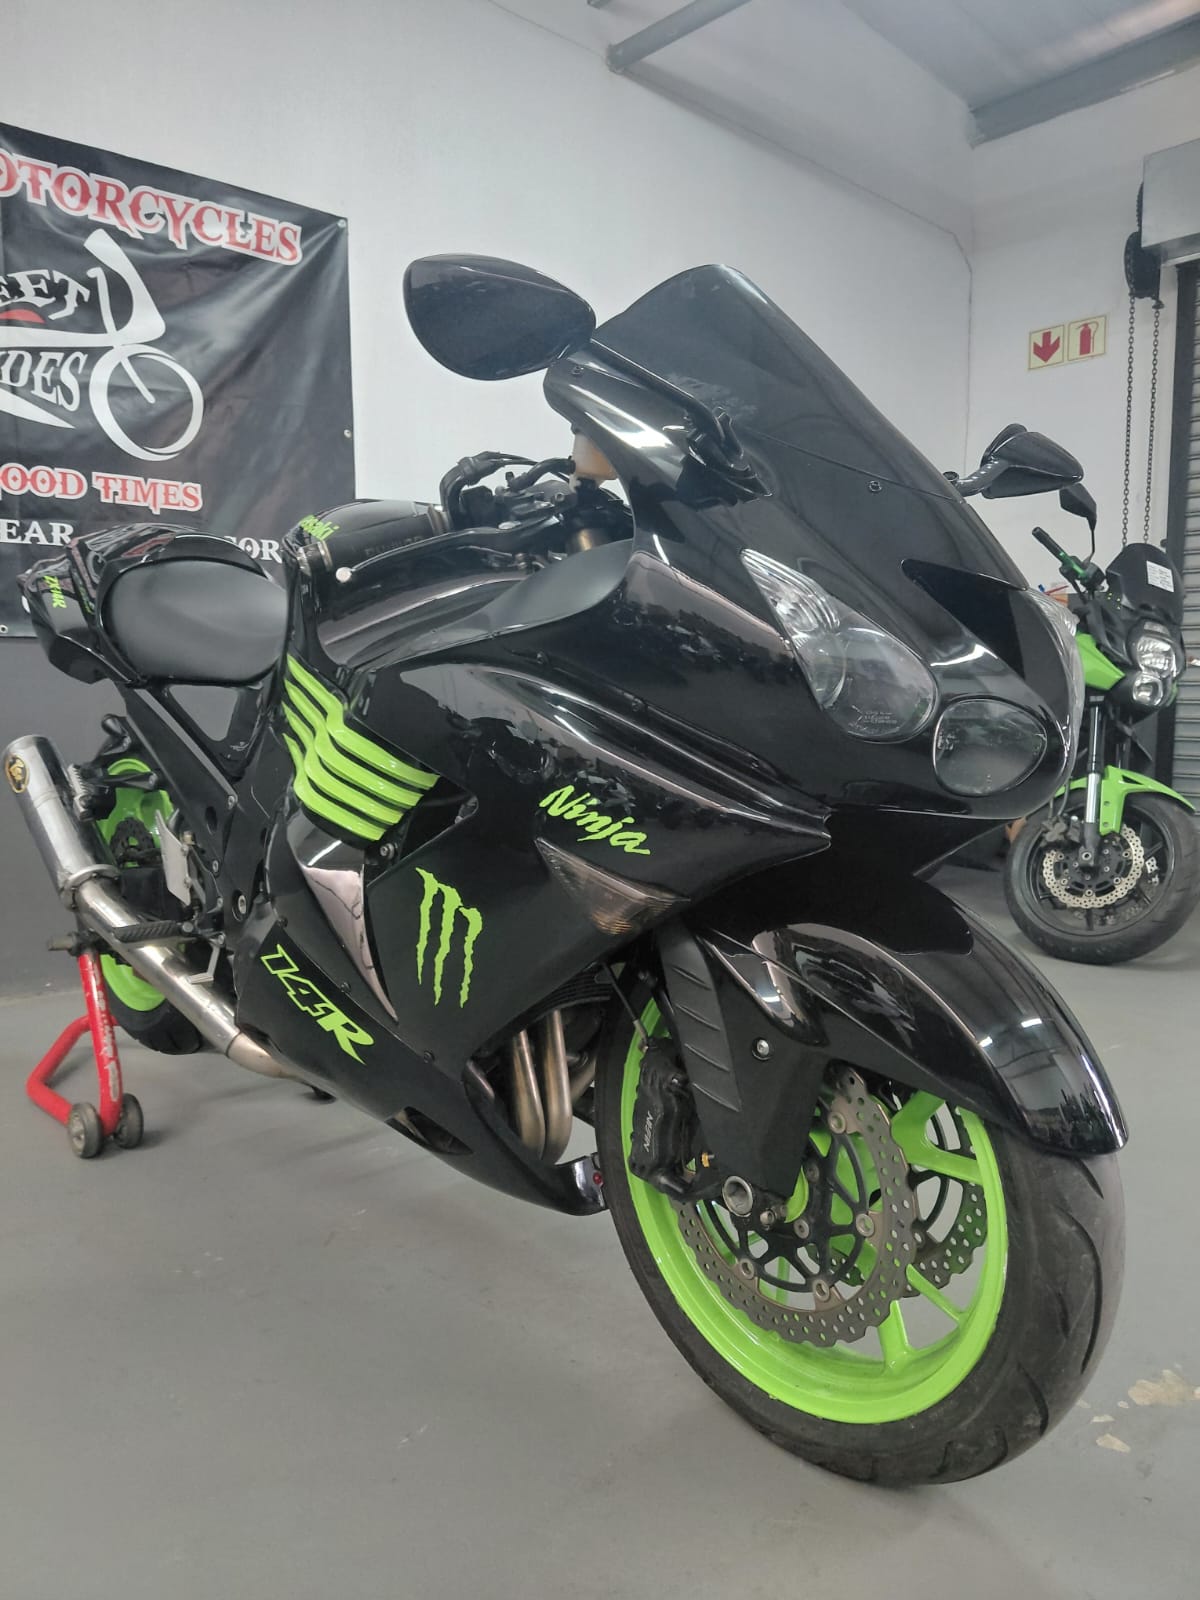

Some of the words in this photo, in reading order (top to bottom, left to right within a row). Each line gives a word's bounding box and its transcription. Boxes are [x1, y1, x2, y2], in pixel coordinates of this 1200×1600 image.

[0, 351, 88, 411] DES
[92, 472, 203, 515] TIMES
[224, 536, 282, 564] OR
[539, 785, 651, 854] Ninja
